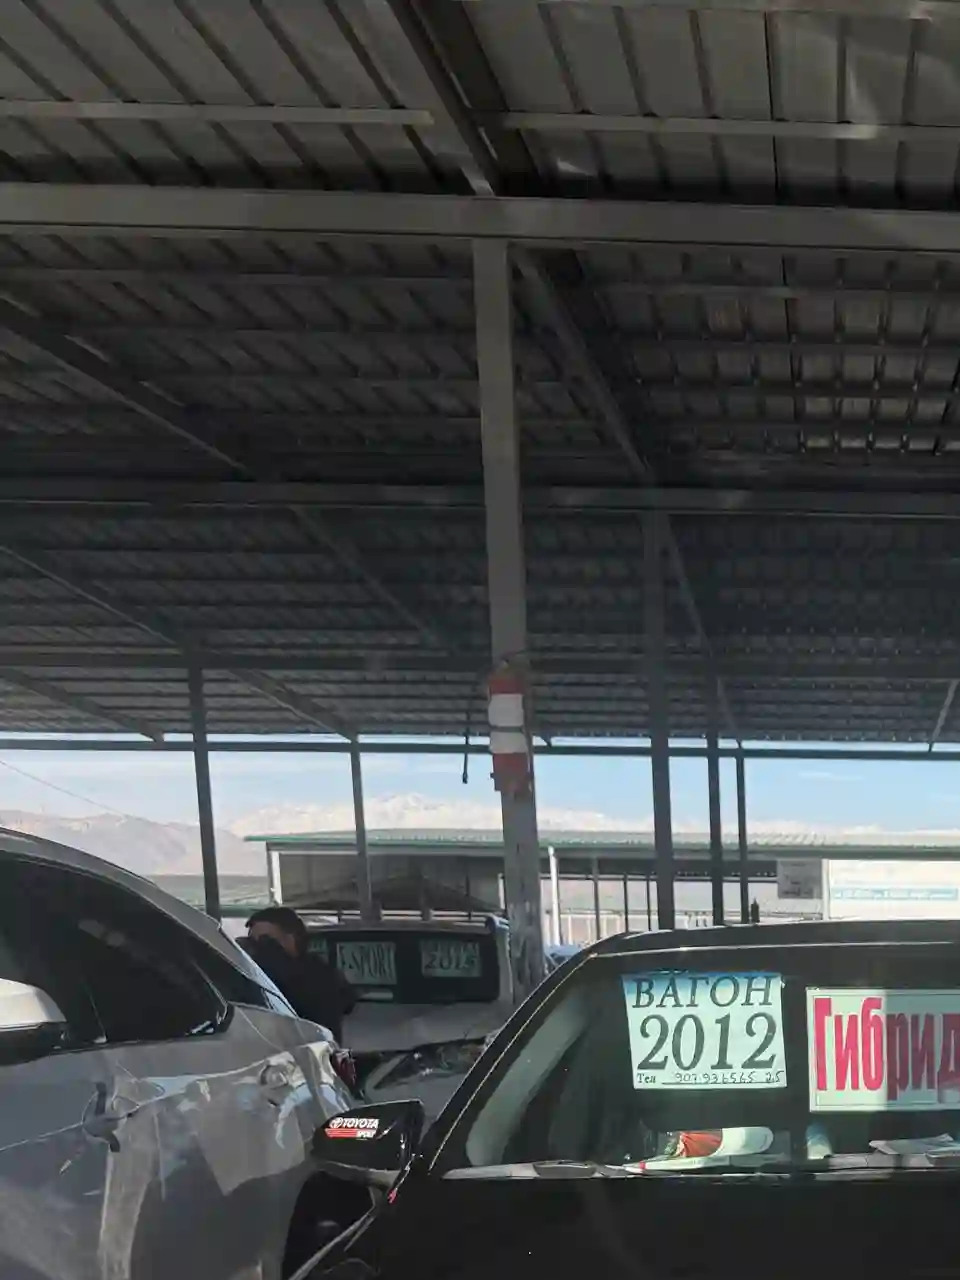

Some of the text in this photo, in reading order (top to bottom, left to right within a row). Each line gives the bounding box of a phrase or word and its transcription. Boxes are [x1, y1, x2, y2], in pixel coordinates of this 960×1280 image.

[632, 975, 778, 1008] ВАГОН
[637, 1012, 777, 1071] 2012
[342, 1118, 379, 1129] TOYOTA
